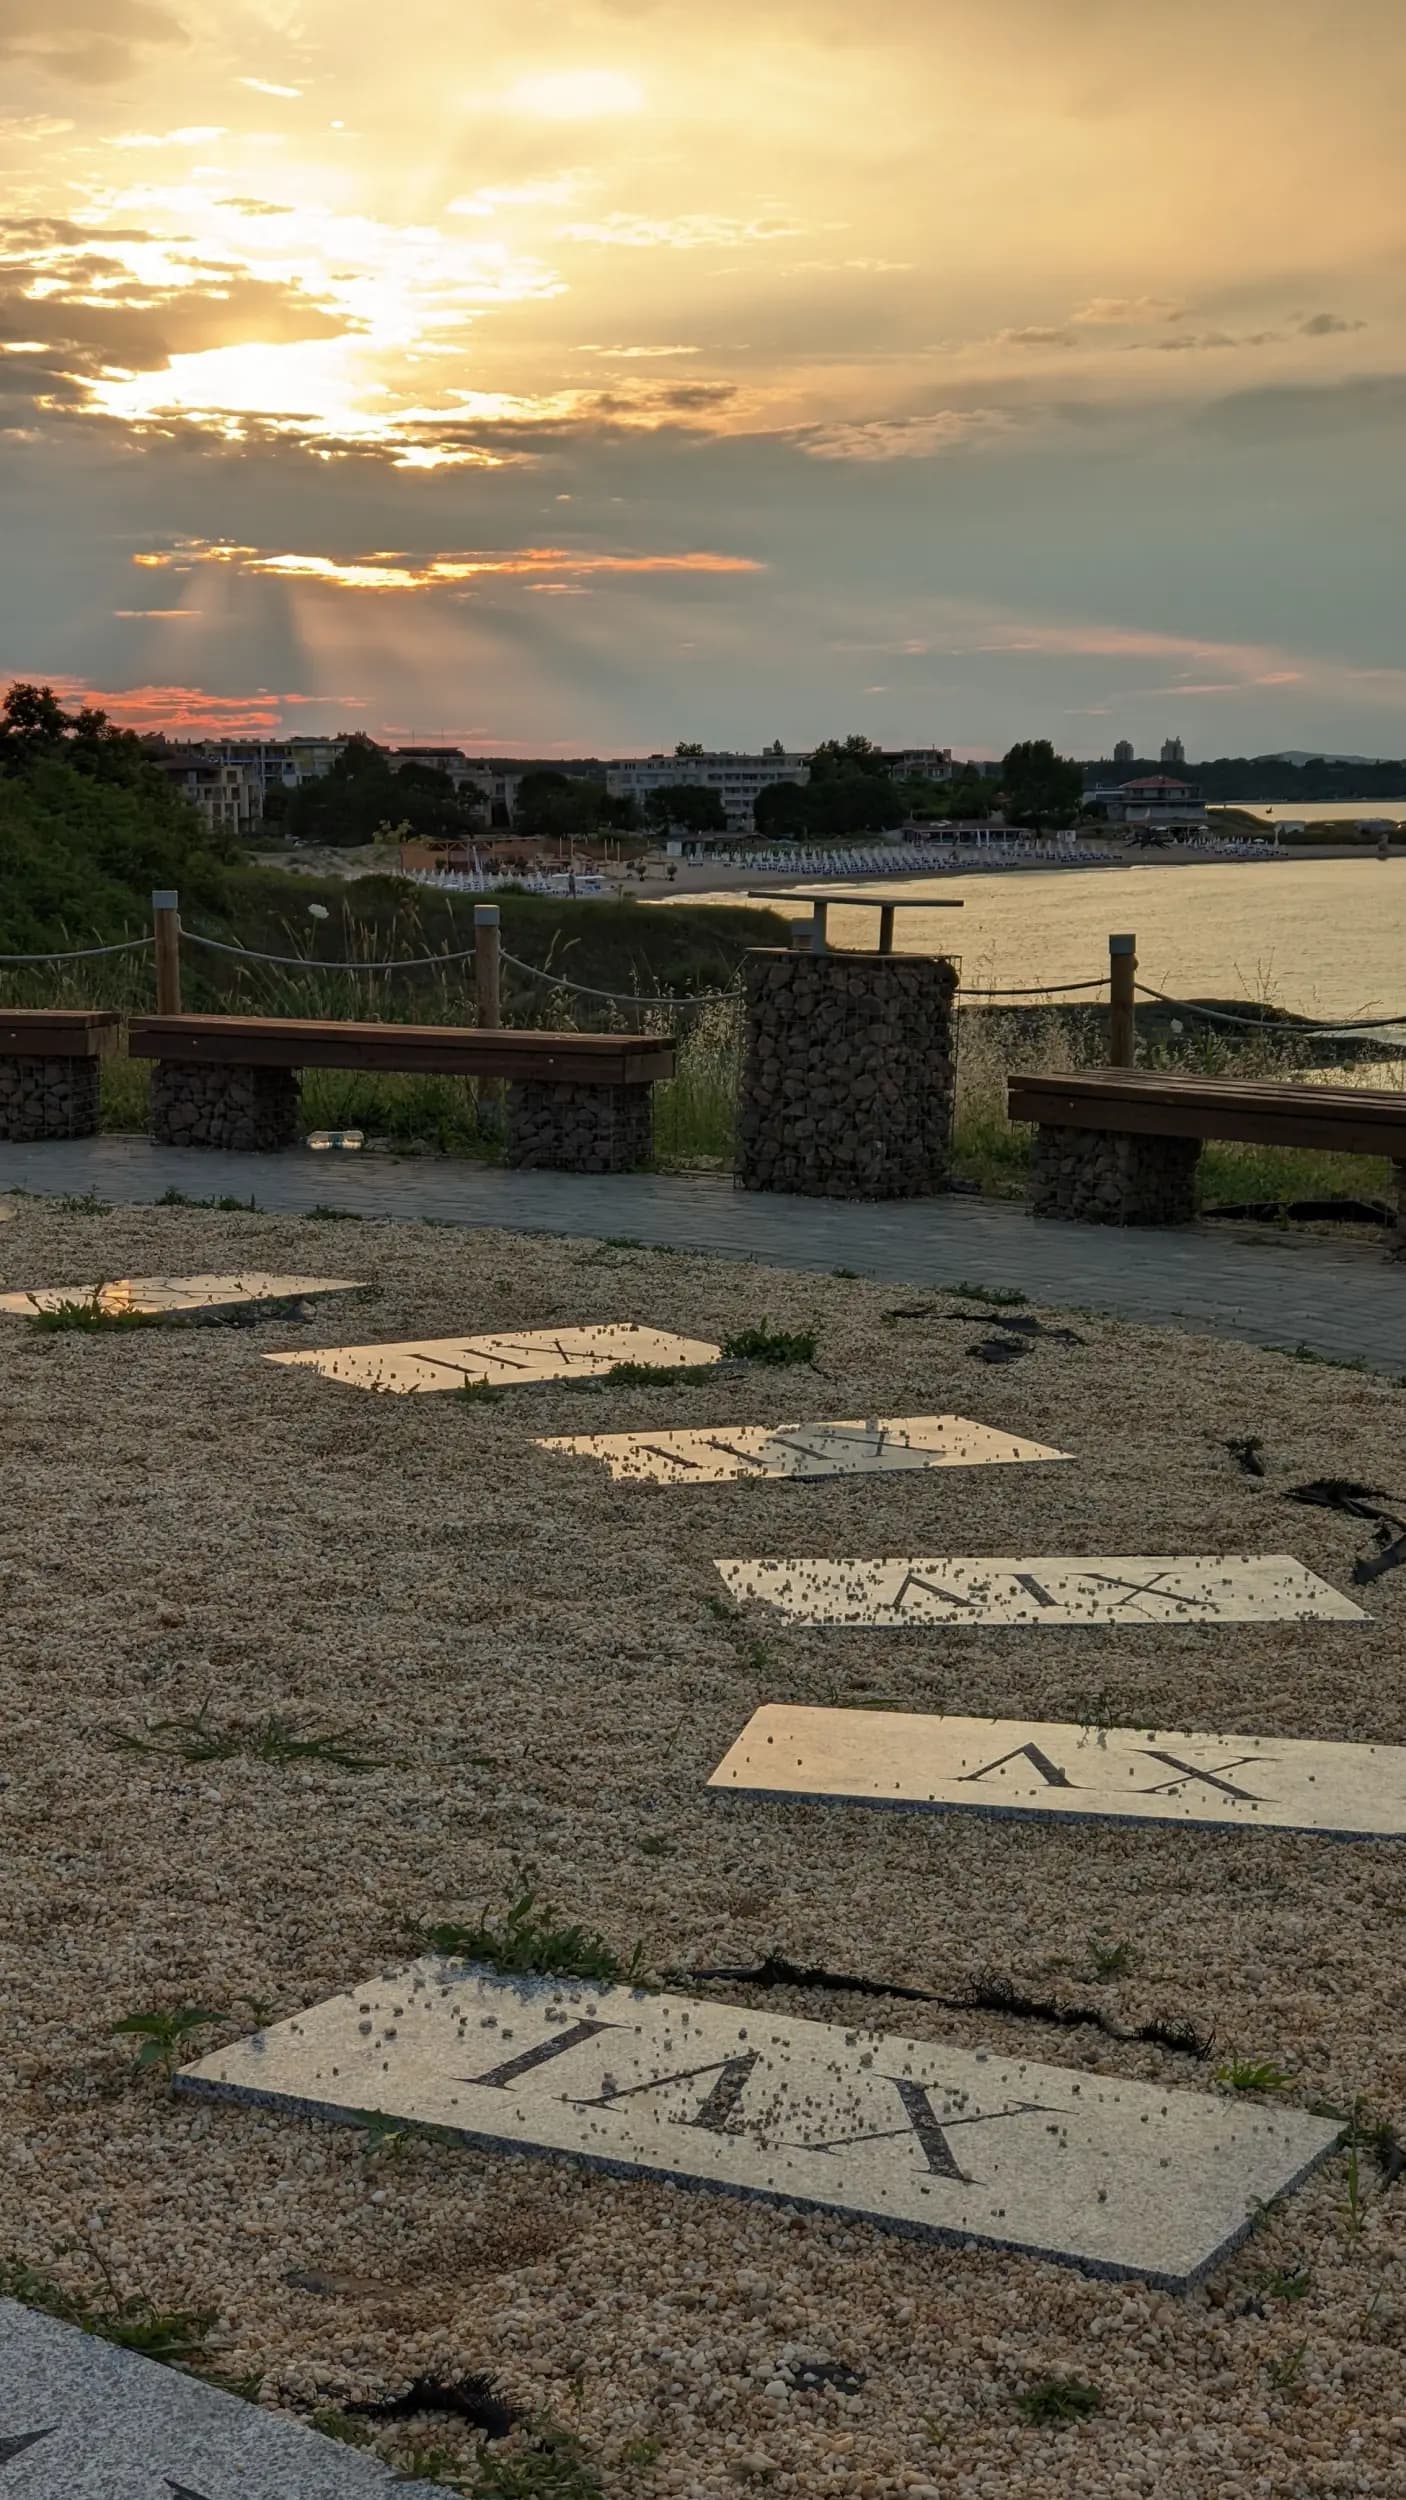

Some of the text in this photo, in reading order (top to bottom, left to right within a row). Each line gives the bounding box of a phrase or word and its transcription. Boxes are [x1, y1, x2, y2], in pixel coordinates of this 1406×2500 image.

[400, 1339, 630, 1374] XII
[632, 1431, 953, 1469] XIII
[889, 1571, 1224, 1609] XIV
[939, 1741, 1283, 1803] XV
[451, 2016, 1080, 2186] XVI
